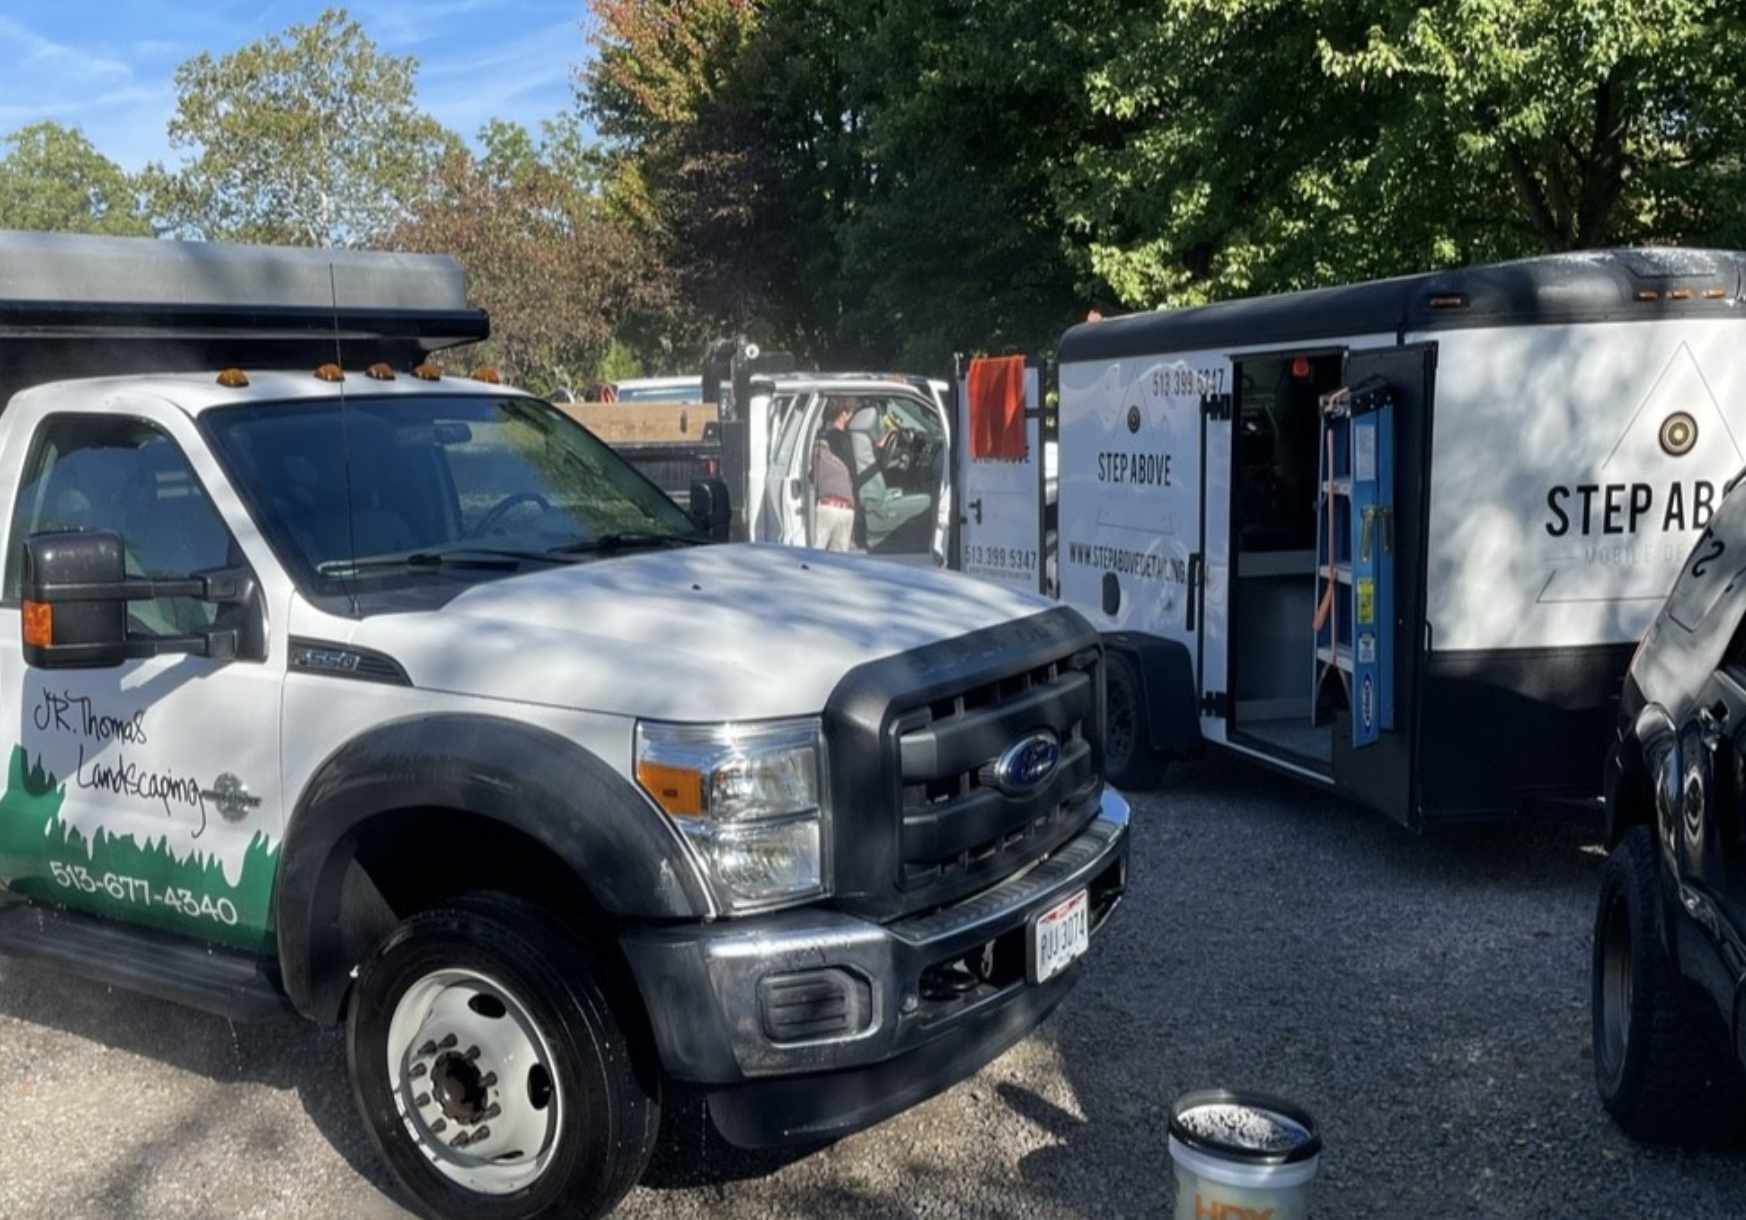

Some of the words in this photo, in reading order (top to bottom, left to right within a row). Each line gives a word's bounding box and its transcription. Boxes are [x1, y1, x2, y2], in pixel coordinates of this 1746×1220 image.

[1098, 452, 1128, 483] STEP
[1130, 453, 1171, 487] ABOVE
[1545, 482, 1653, 537] STEP
[1662, 479, 1733, 532] AB
[965, 544, 1037, 570] 513.399.5347
[1585, 544, 1652, 566] MOBILE
[1664, 544, 1686, 562] DE
[77, 744, 206, 839] Landscaping
[50, 860, 237, 926] 513-677-4340
